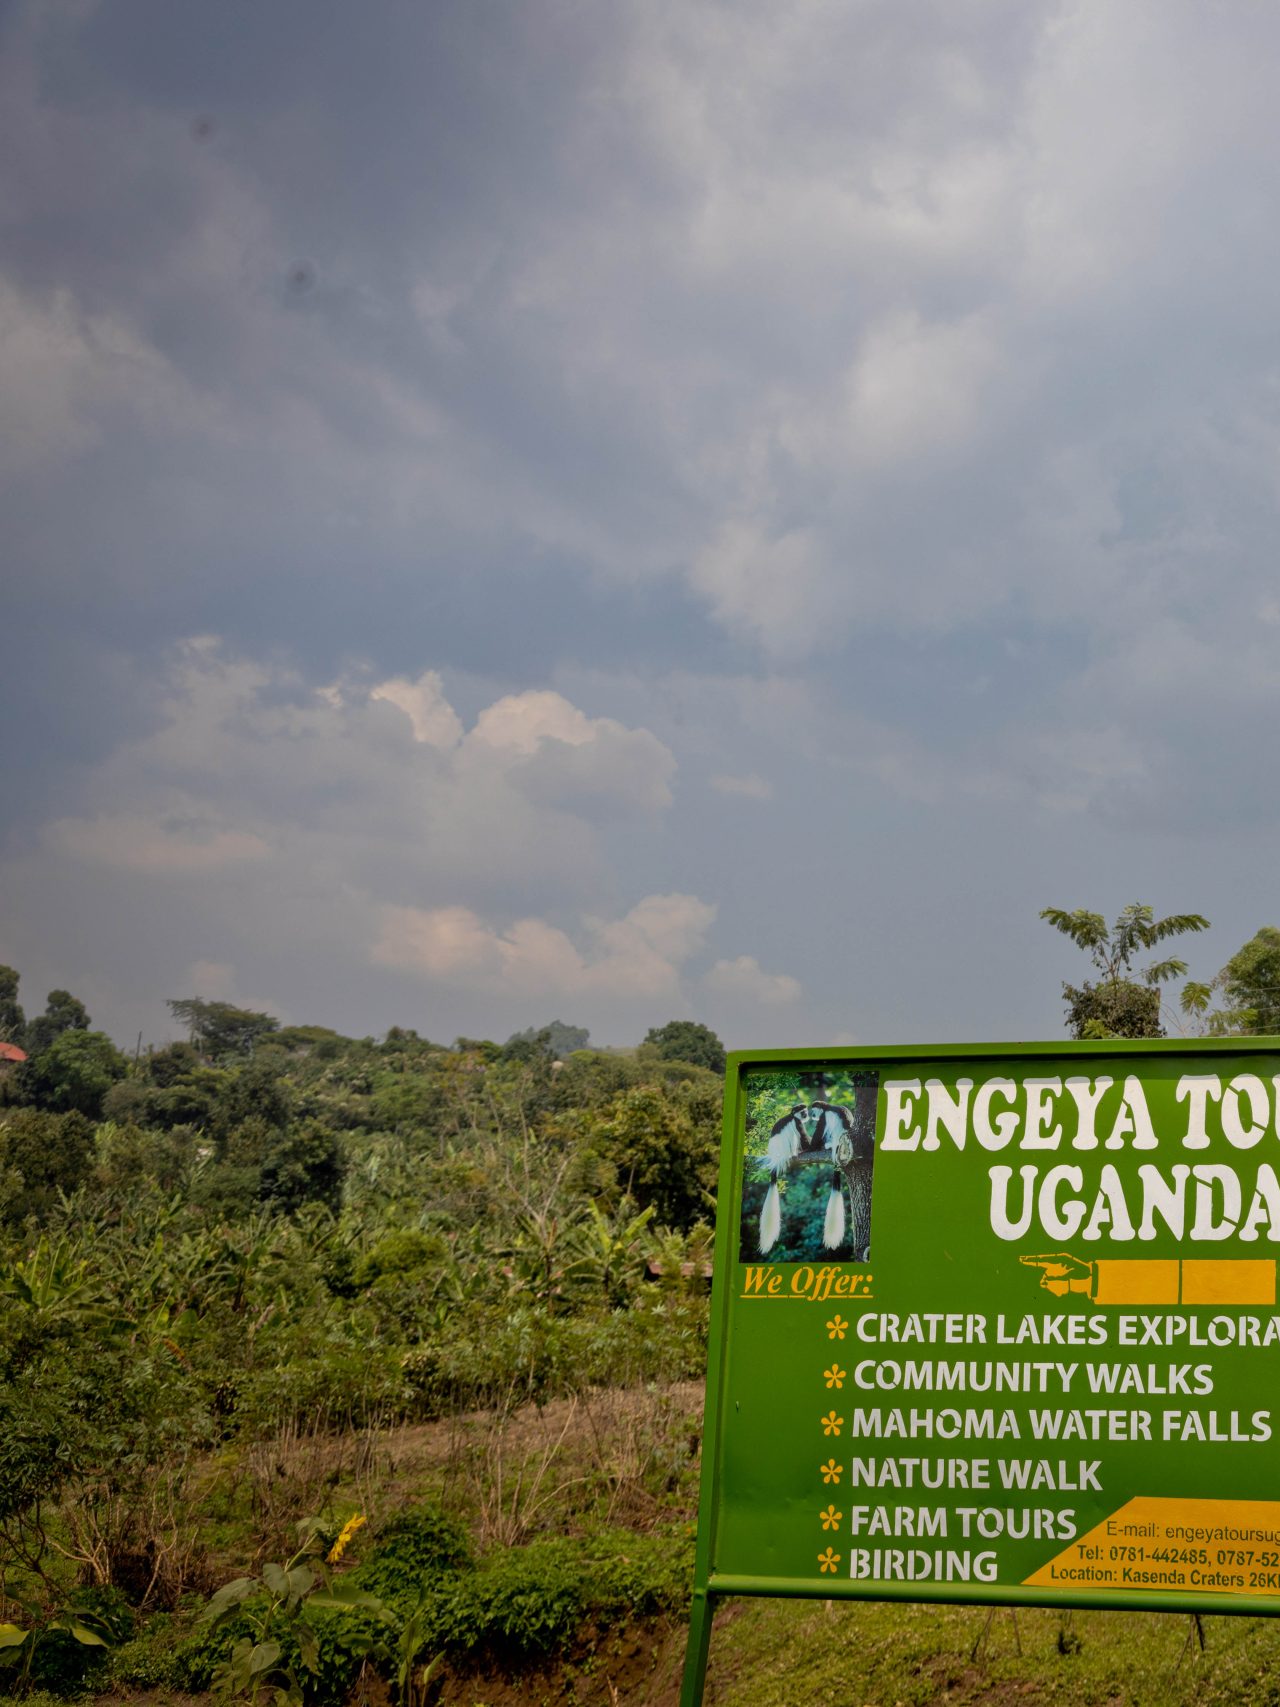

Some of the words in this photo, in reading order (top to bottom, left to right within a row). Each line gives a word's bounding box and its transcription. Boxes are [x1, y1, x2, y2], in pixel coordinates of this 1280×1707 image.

[880, 1075, 1159, 1151] ENGEYA
[743, 1266, 783, 1294] We
[790, 1266, 873, 1301] Offer:
[856, 1312, 987, 1343] CRATER
[996, 1314, 1108, 1345] LAKES
[854, 1359, 1079, 1393] COMMUNITY
[1085, 1363, 1214, 1395] WALKS
[852, 1408, 1021, 1439] MAHOMA
[1029, 1409, 1153, 1441] WATER
[1162, 1410, 1273, 1442] FALLS
[852, 1457, 990, 1489] NATURE
[997, 1459, 1103, 1491] WALK
[851, 1505, 948, 1537] FARM
[955, 1507, 1077, 1540] TOURS
[1107, 1521, 1160, 1537] E-mail:
[849, 1548, 998, 1582] BIRDING
[1077, 1545, 1103, 1561] Tel:
[1109, 1546, 1212, 1567] 0781-442485,
[1051, 1565, 1118, 1582] Location:
[1122, 1567, 1186, 1585] Kasenda
[1190, 1570, 1245, 1587] Craters
